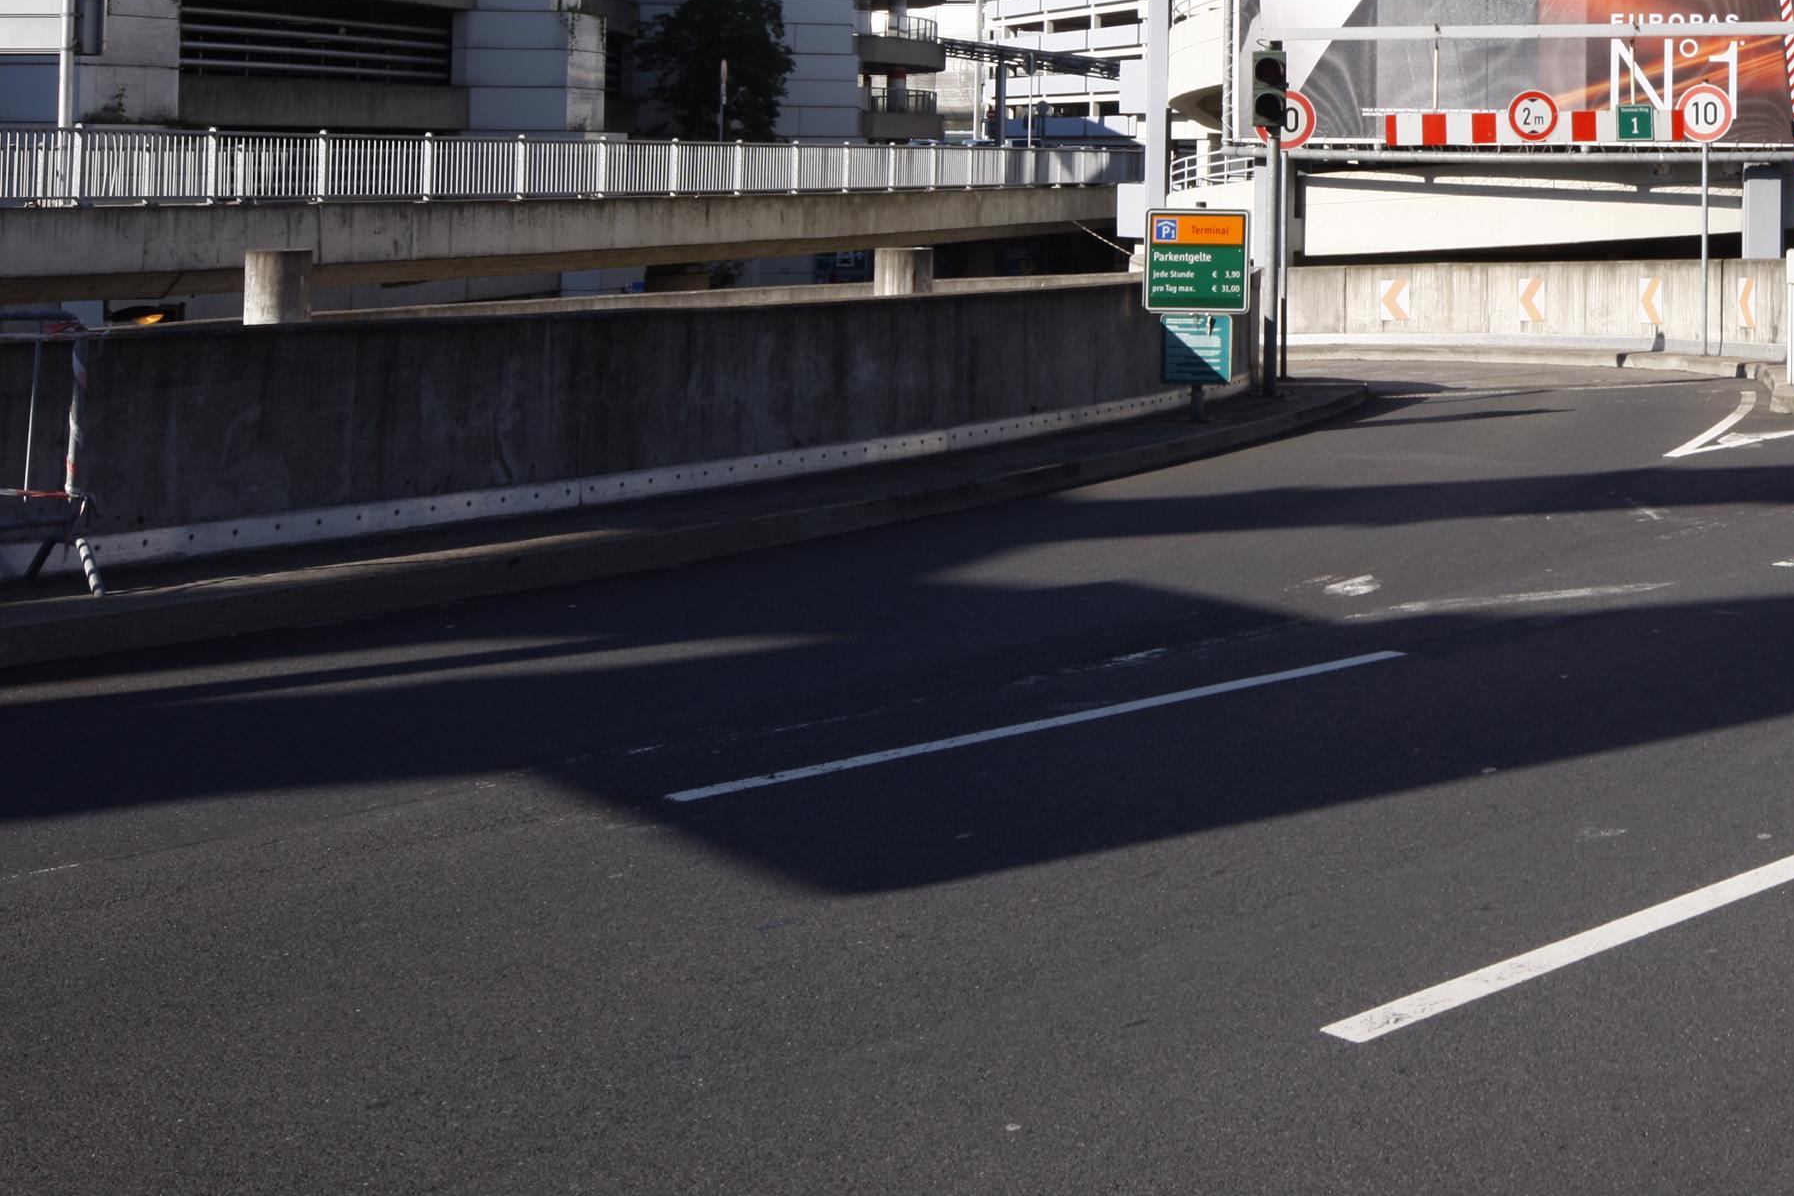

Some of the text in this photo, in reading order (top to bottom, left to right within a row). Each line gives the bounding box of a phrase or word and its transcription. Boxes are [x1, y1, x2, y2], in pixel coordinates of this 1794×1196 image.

[1692, 101, 1718, 126] 10
[1631, 116, 1640, 134] 1
[1192, 225, 1230, 235] Terminal
[1154, 252, 1212, 265] Parkentgelte
[1153, 270, 1240, 279] jede Stunde € 3,90
[1164, 284, 1177, 294] Tag
[1221, 285, 1240, 293] 31,00
